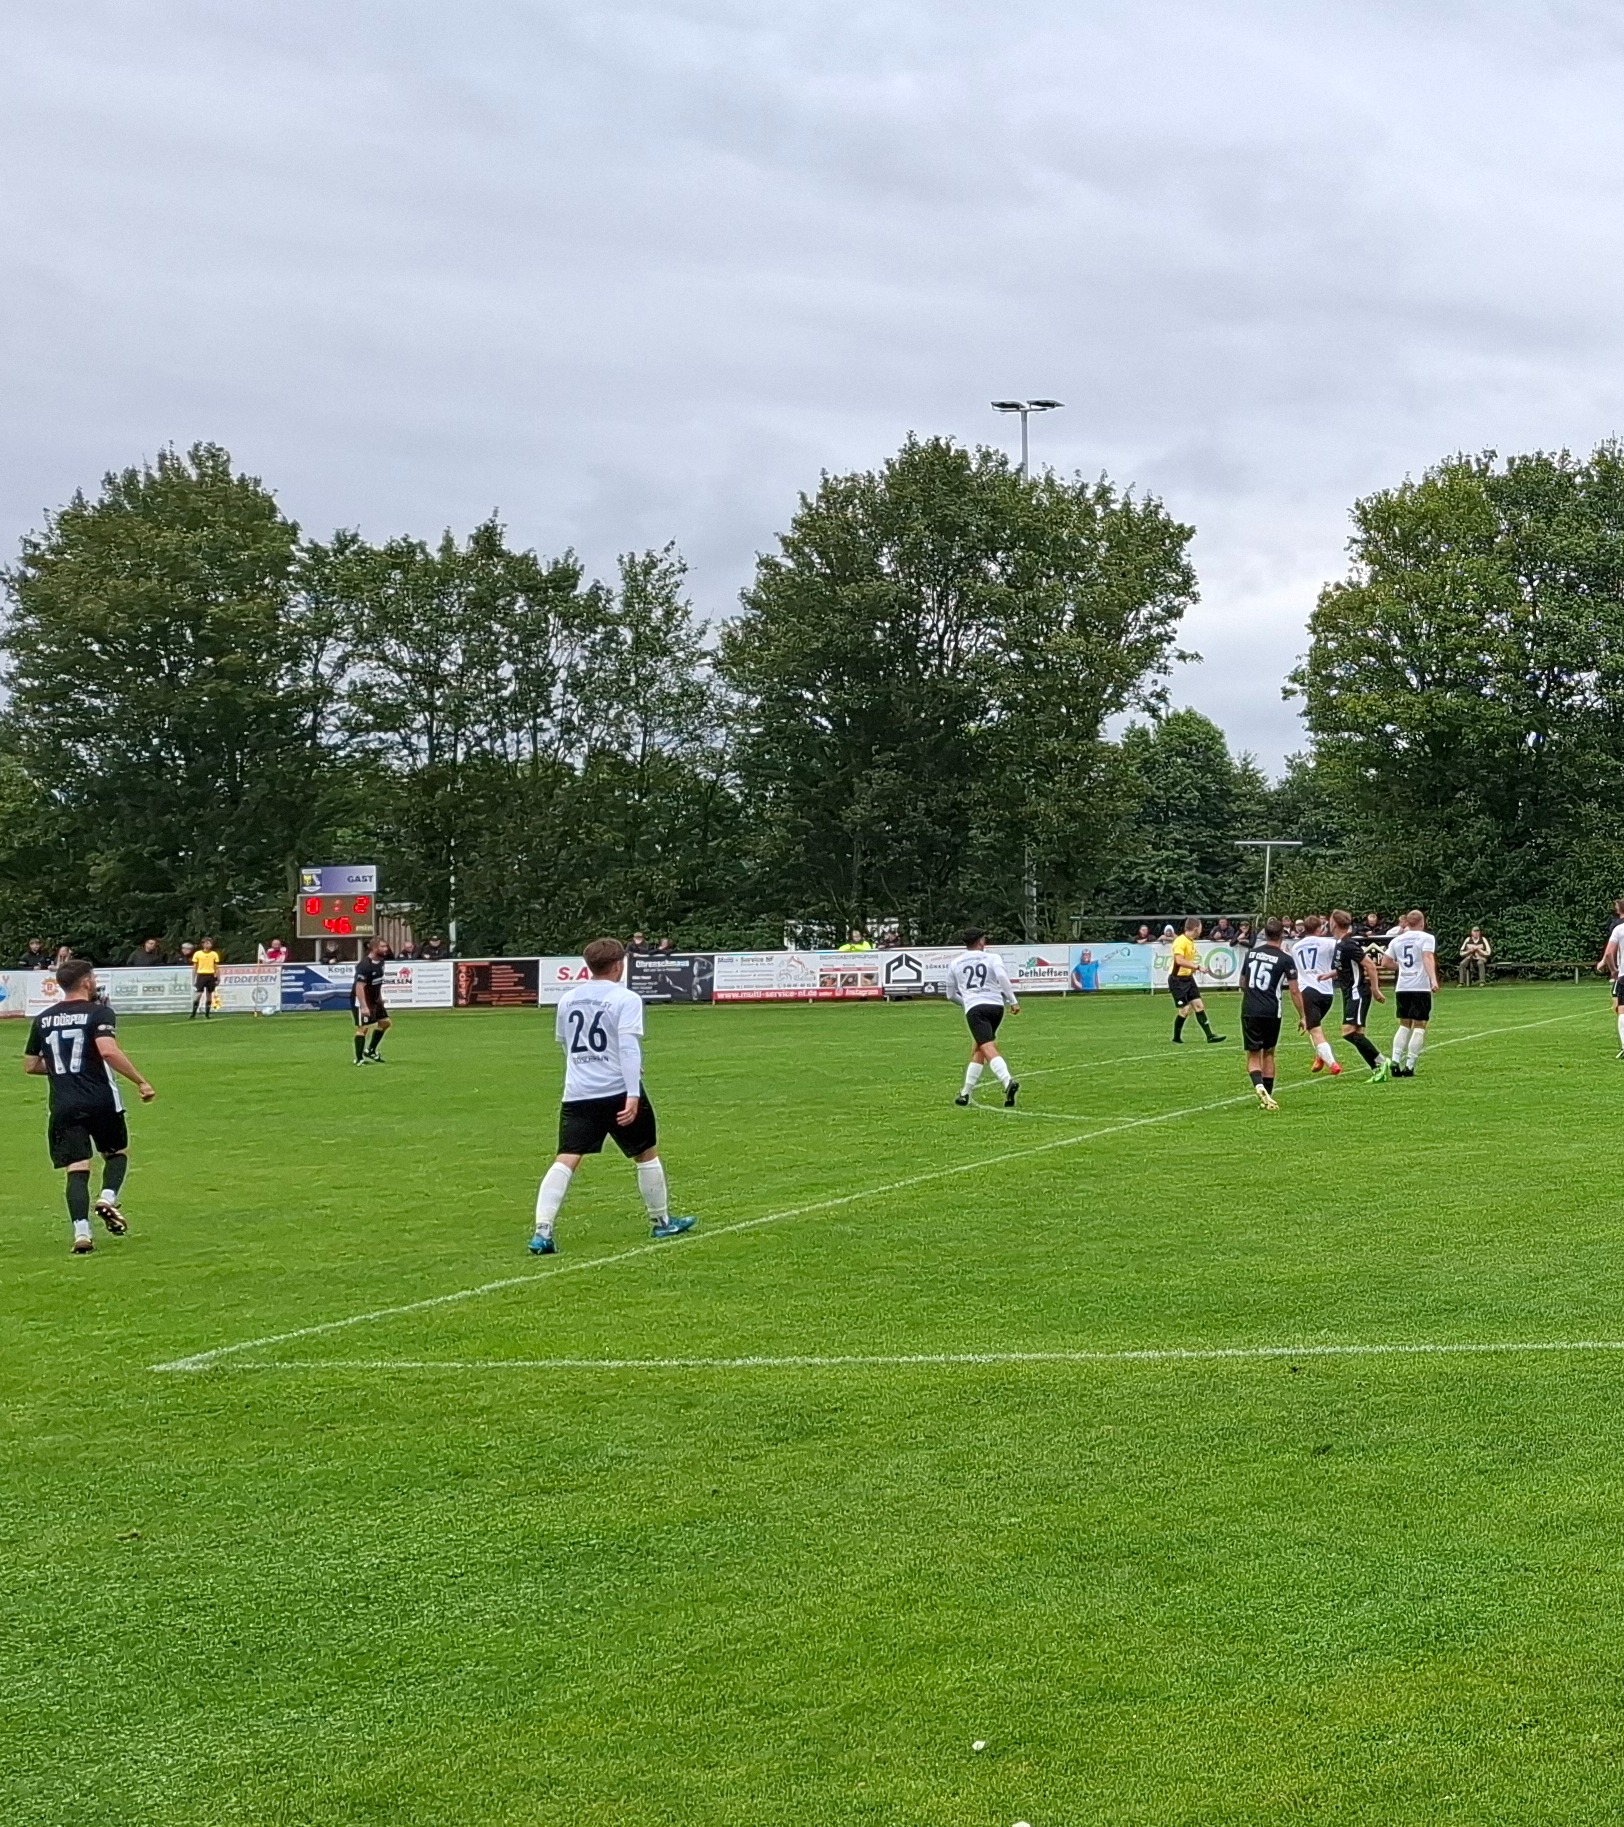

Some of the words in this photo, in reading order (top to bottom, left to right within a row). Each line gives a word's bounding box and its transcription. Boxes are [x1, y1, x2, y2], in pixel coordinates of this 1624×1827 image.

[347, 875, 373, 883] GAST
[306, 897, 320, 915] 0
[353, 896, 369, 914] 2
[1298, 948, 1318, 970] 17
[1403, 945, 1414, 968] 5
[224, 975, 277, 984] FEDDERSEN
[963, 963, 987, 989] 29
[1018, 968, 1069, 978] Dethleffsen
[1248, 960, 1273, 991] 15
[41, 1015, 52, 1028] SV
[568, 1010, 607, 1053] 26
[45, 1028, 84, 1074] 17
